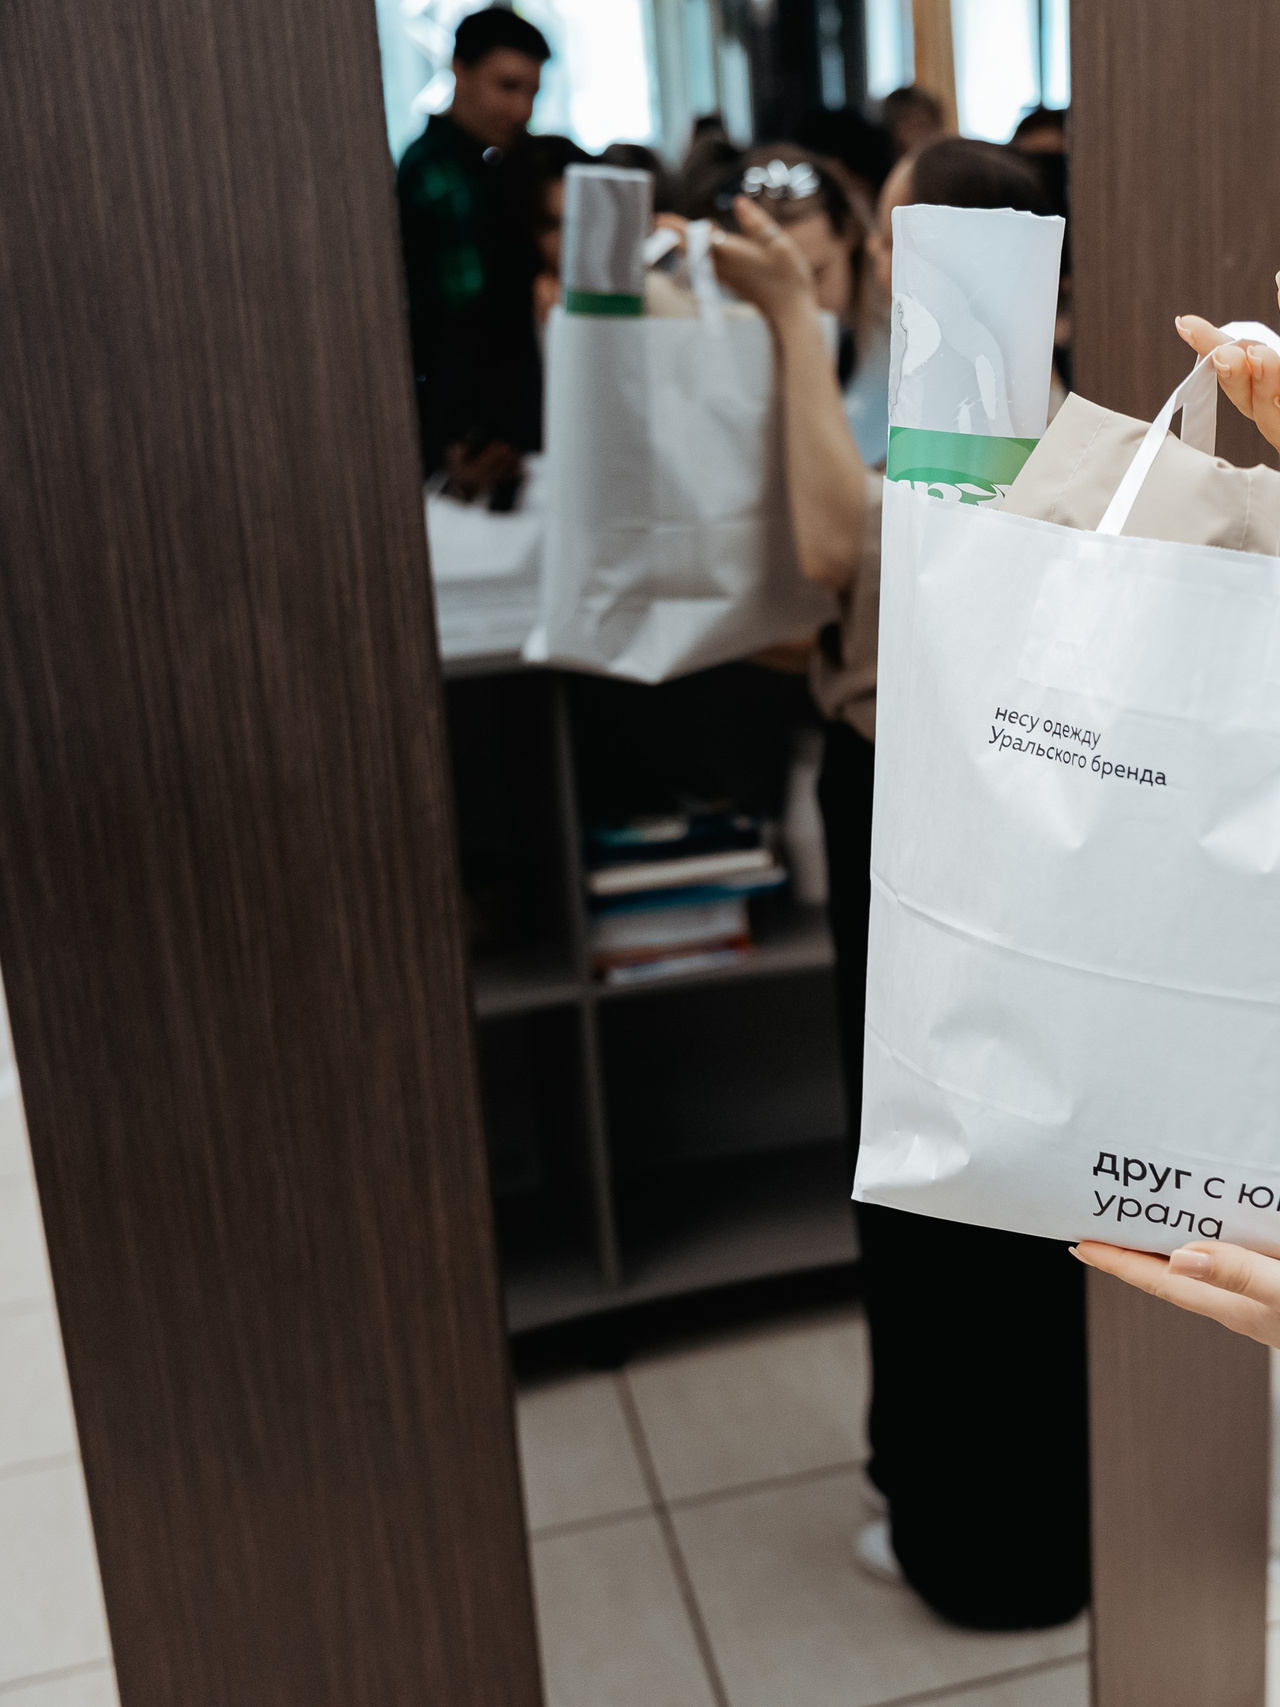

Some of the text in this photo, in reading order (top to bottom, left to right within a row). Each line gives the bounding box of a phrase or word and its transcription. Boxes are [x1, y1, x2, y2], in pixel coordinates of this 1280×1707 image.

[994, 706, 1102, 751] несу одежду
[988, 725, 1167, 787] Уральского бренда
[1092, 1151, 1192, 1194] друг
[1203, 1177, 1226, 1199] с
[1092, 1190, 1224, 1241] урала
